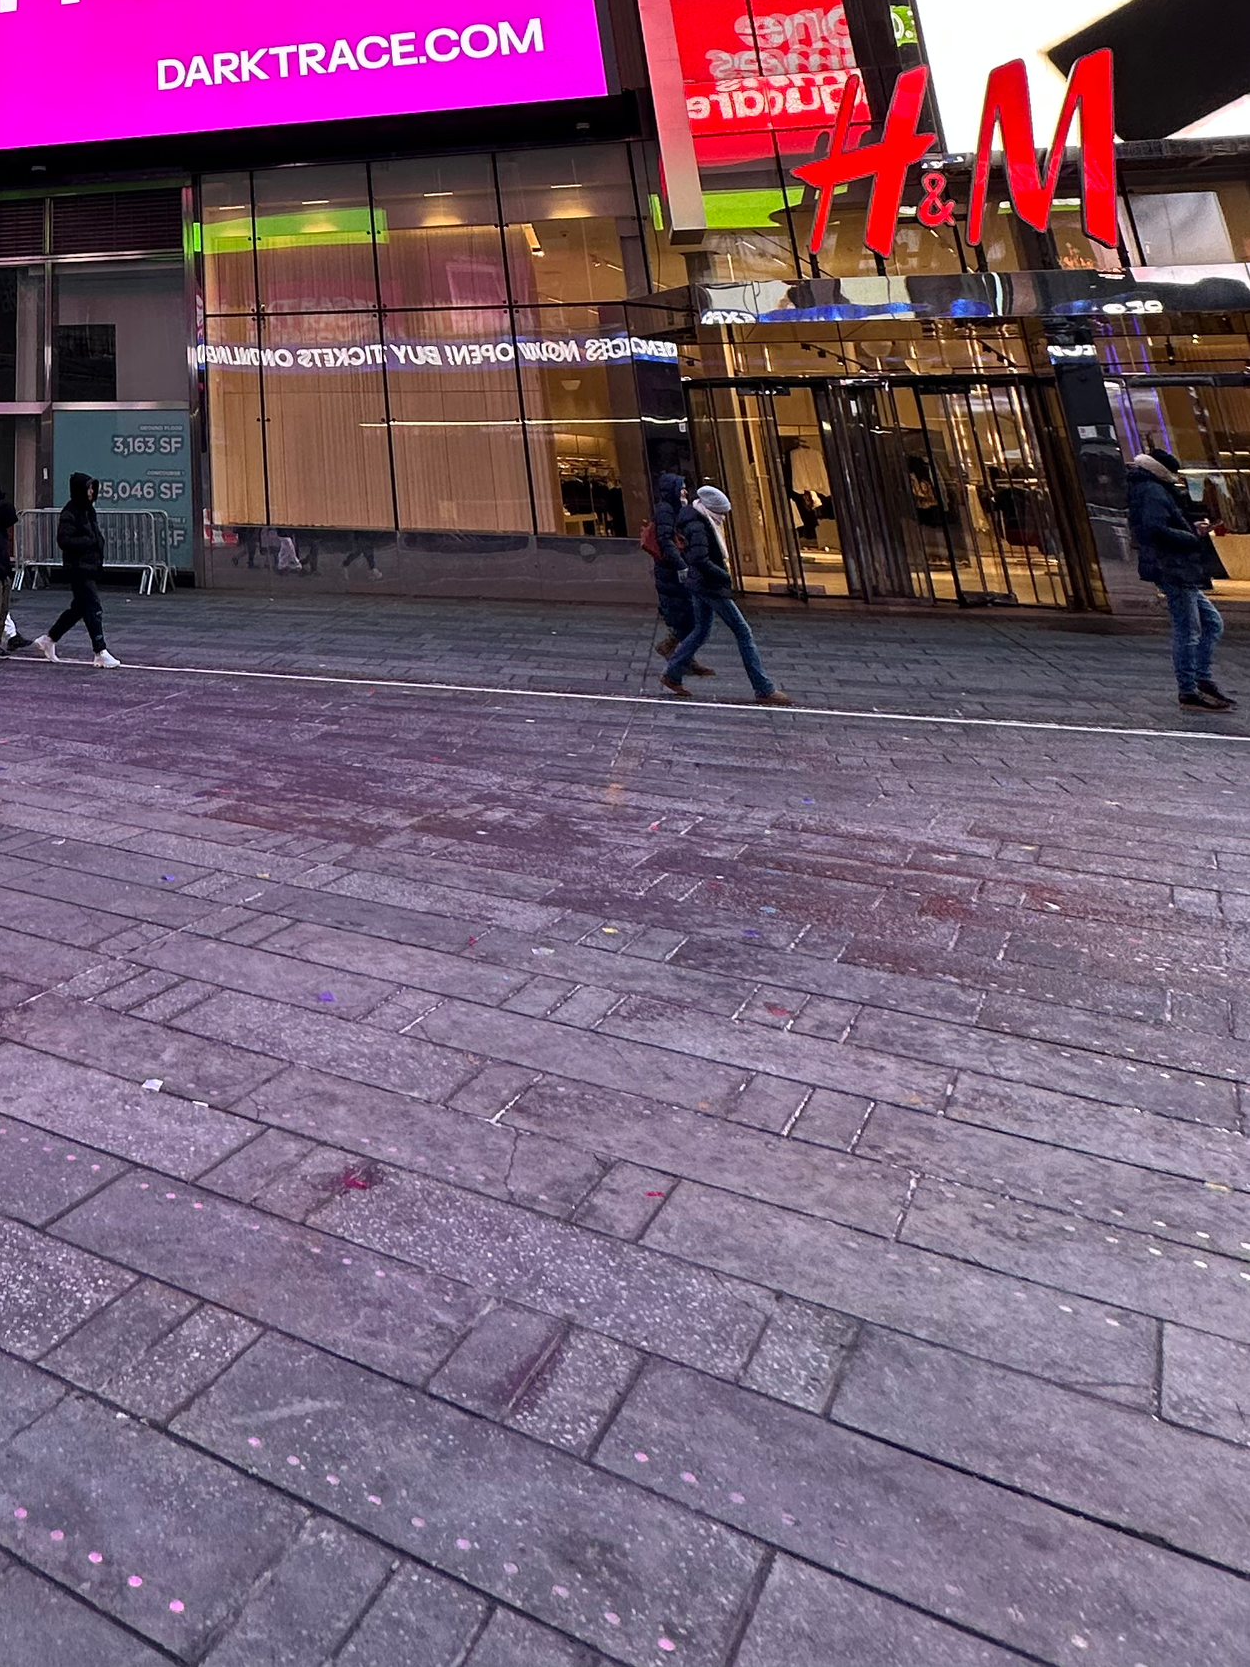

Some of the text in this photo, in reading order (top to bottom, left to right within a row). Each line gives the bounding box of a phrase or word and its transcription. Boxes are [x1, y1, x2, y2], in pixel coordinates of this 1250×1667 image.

[157, 17, 545, 91] DARKTRACE.COM
[792, 48, 1117, 258] H&M
[113, 437, 182, 455] 3,163 SF
[159, 483, 183, 499] SF
